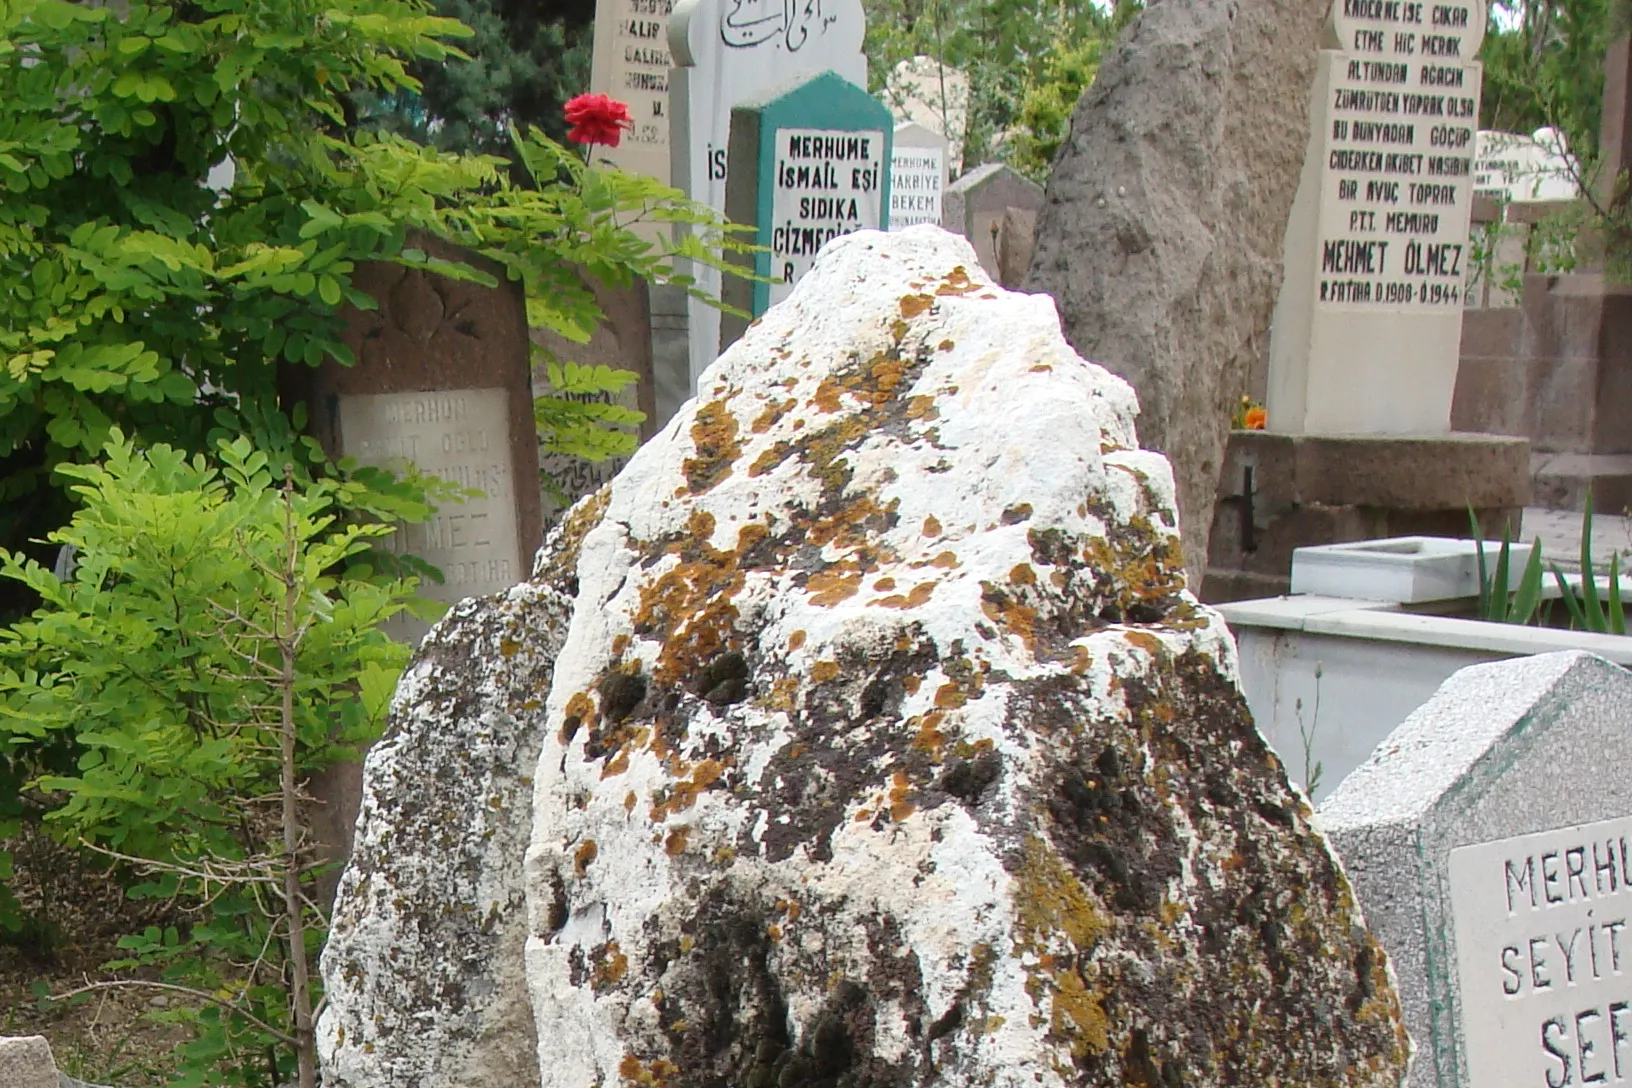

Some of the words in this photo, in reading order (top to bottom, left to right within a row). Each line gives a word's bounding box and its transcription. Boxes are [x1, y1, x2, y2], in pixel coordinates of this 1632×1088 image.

[1354, 29, 1384, 51] ETME
[1394, 31, 1415, 55] HİÇ
[1421, 34, 1461, 57] MERAK
[1333, 119, 1348, 141] BU
[789, 135, 871, 161] MERHUME
[778, 159, 839, 191] İSMAİL
[852, 159, 879, 193] EŞİ
[891, 194, 935, 212] BEKEM
[1339, 178, 1358, 200] BİR
[1366, 180, 1400, 206] AVUÇ
[1408, 182, 1457, 206] TOPRAK
[799, 197, 859, 221] SIDIKA
[1322, 238, 1390, 275] MEHMET
[1403, 238, 1464, 277] ÖLMEZ
[1501, 909, 1626, 995] SEYİT
